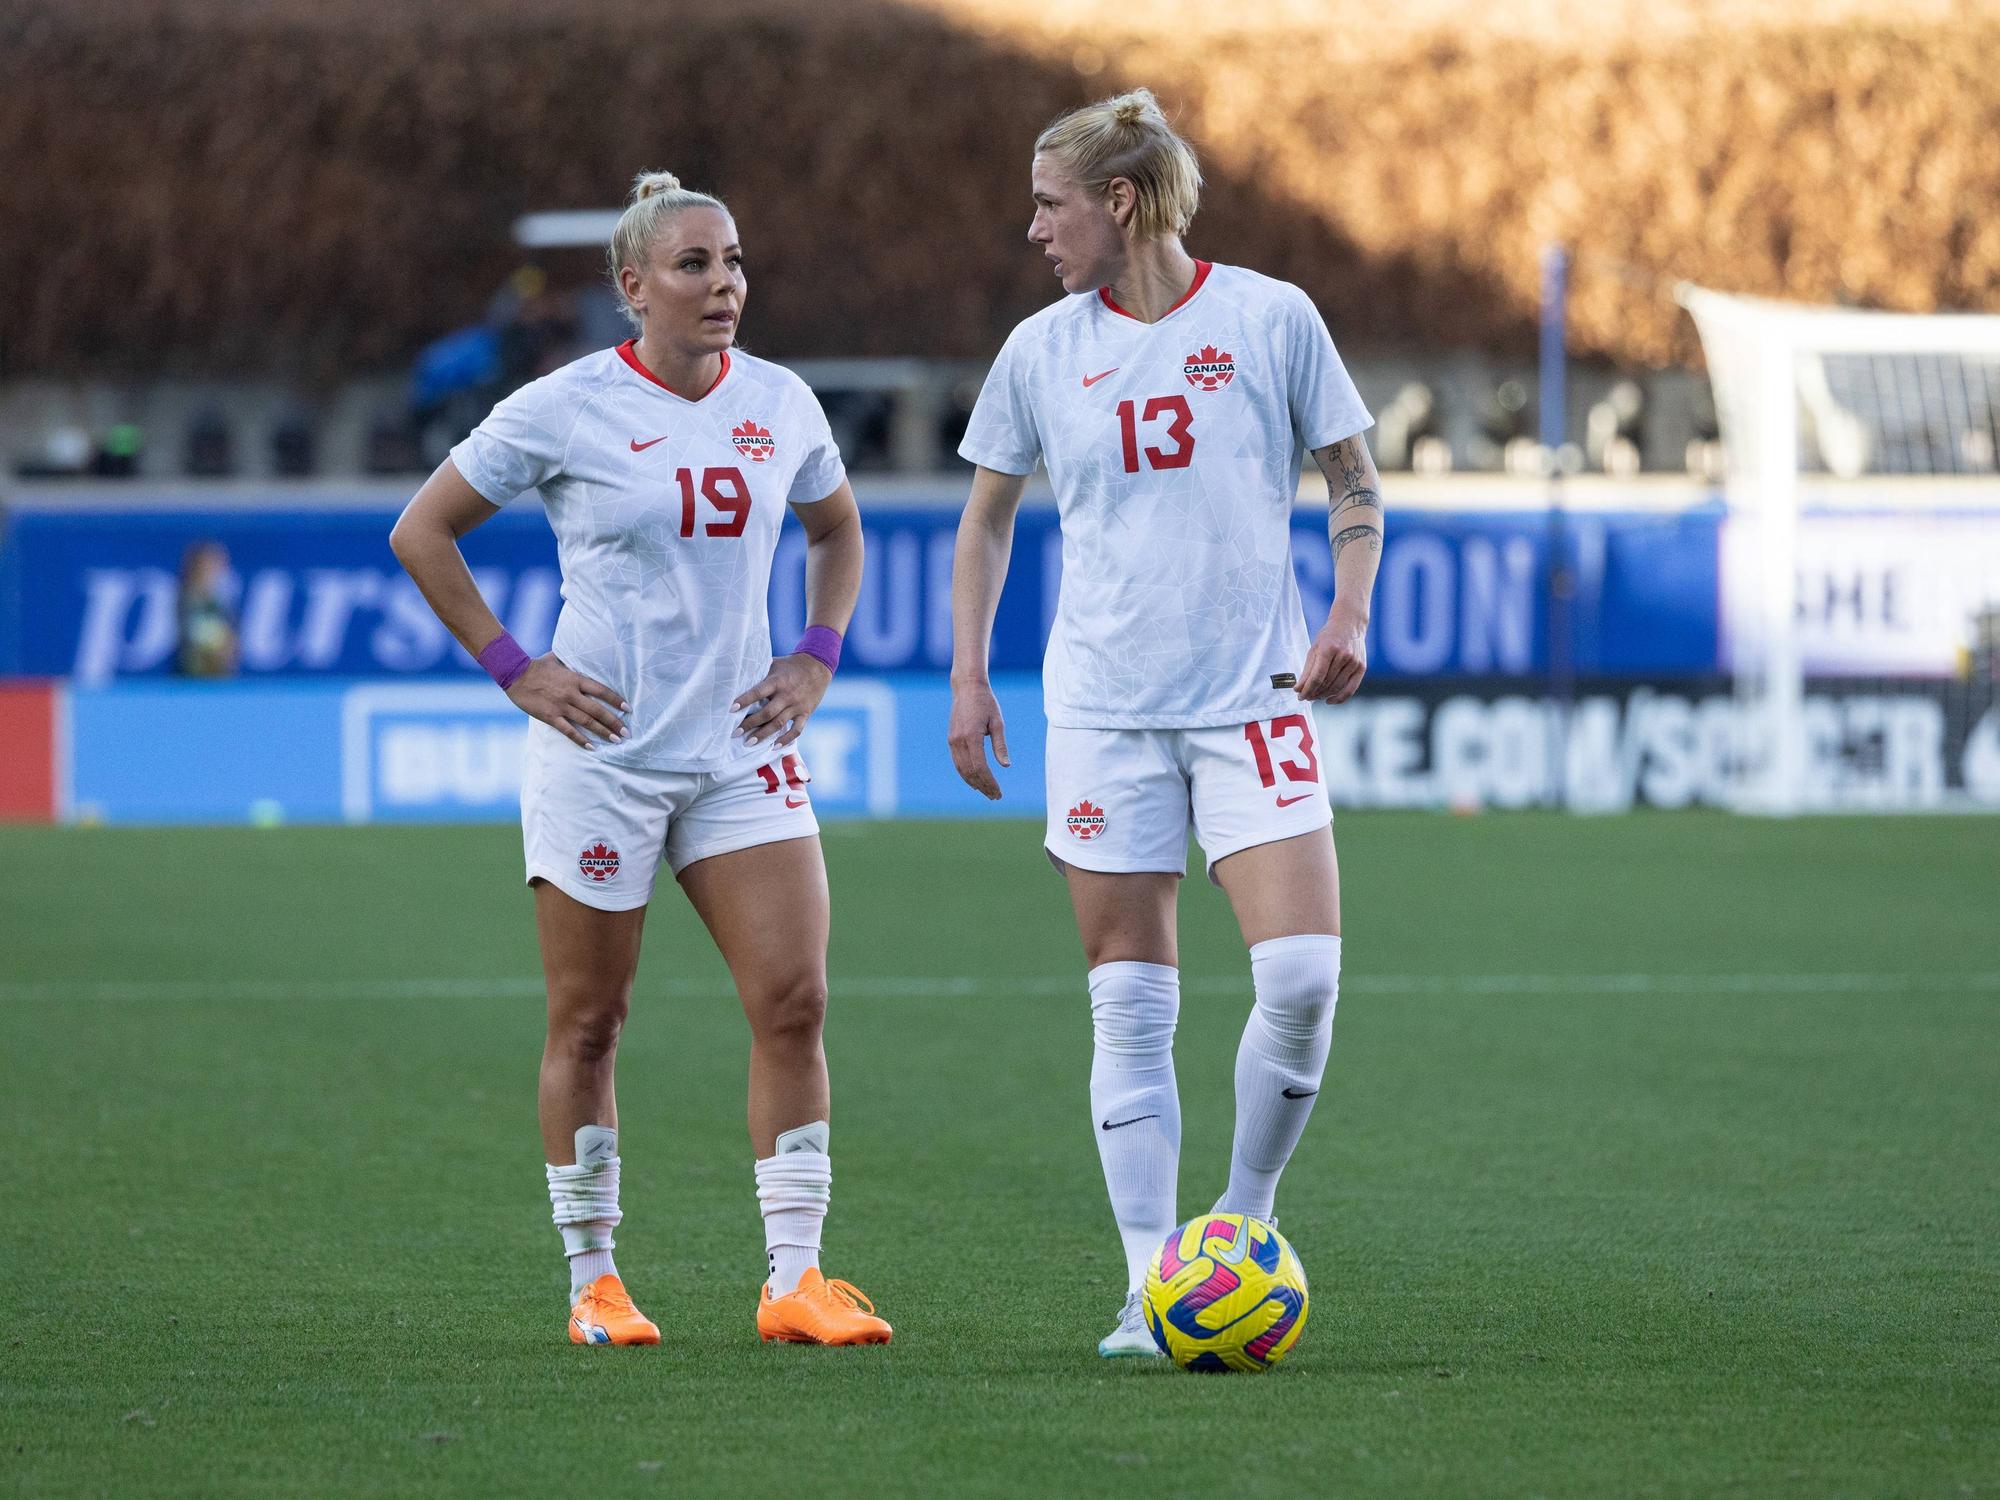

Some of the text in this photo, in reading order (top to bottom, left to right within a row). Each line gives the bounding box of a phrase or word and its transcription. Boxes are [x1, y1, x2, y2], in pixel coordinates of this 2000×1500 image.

[1183, 363, 1236, 374] CANADA
[732, 437, 776, 446] CANADA
[1116, 394, 1196, 474] 13
[675, 466, 753, 538] 19
[72, 562, 560, 690] pursu
[1244, 713, 1319, 789] 13
[1066, 816, 1105, 824] CANADA
